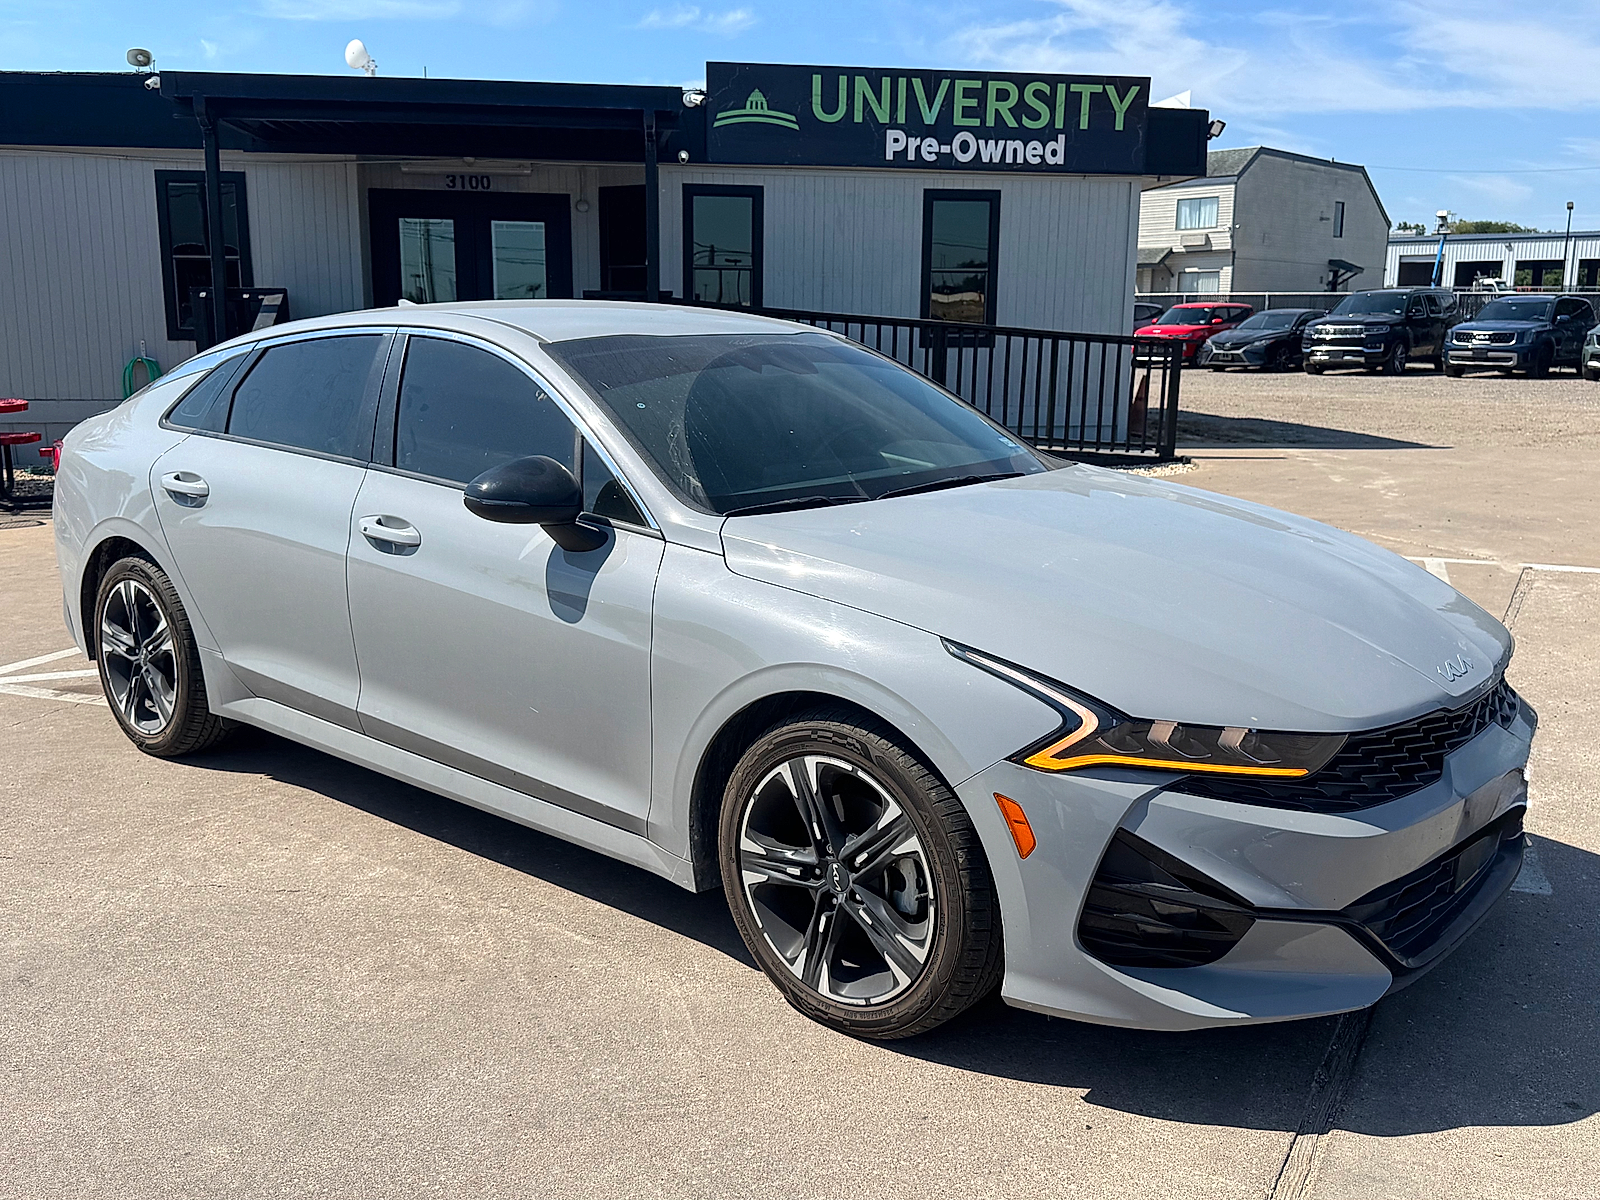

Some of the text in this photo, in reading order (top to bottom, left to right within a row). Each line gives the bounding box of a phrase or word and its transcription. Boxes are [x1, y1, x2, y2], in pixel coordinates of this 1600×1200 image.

[812, 74, 1139, 130] UNIVERSITY
[885, 129, 1066, 165] Pre-Owned
[446, 175, 491, 189] 3100
